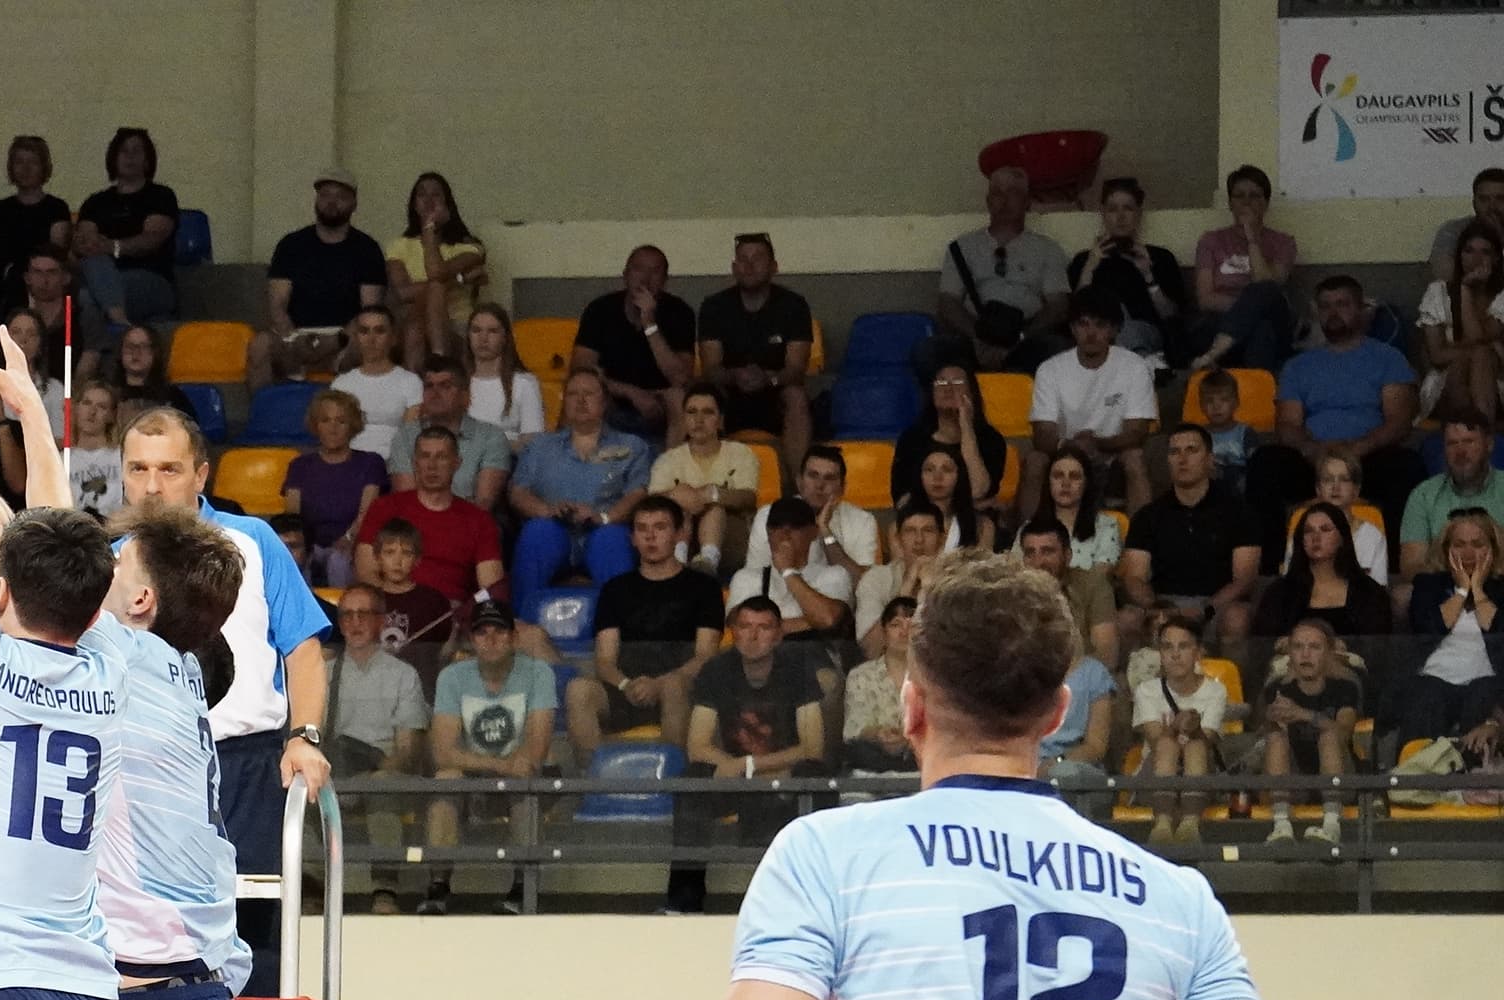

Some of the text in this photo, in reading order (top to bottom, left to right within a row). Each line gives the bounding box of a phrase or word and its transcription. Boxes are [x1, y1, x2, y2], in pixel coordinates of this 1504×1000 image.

[1355, 94, 1461, 109] DAUGAVPILS
[0, 723, 102, 851] 13
[907, 824, 1147, 907] VOULKIDIS
